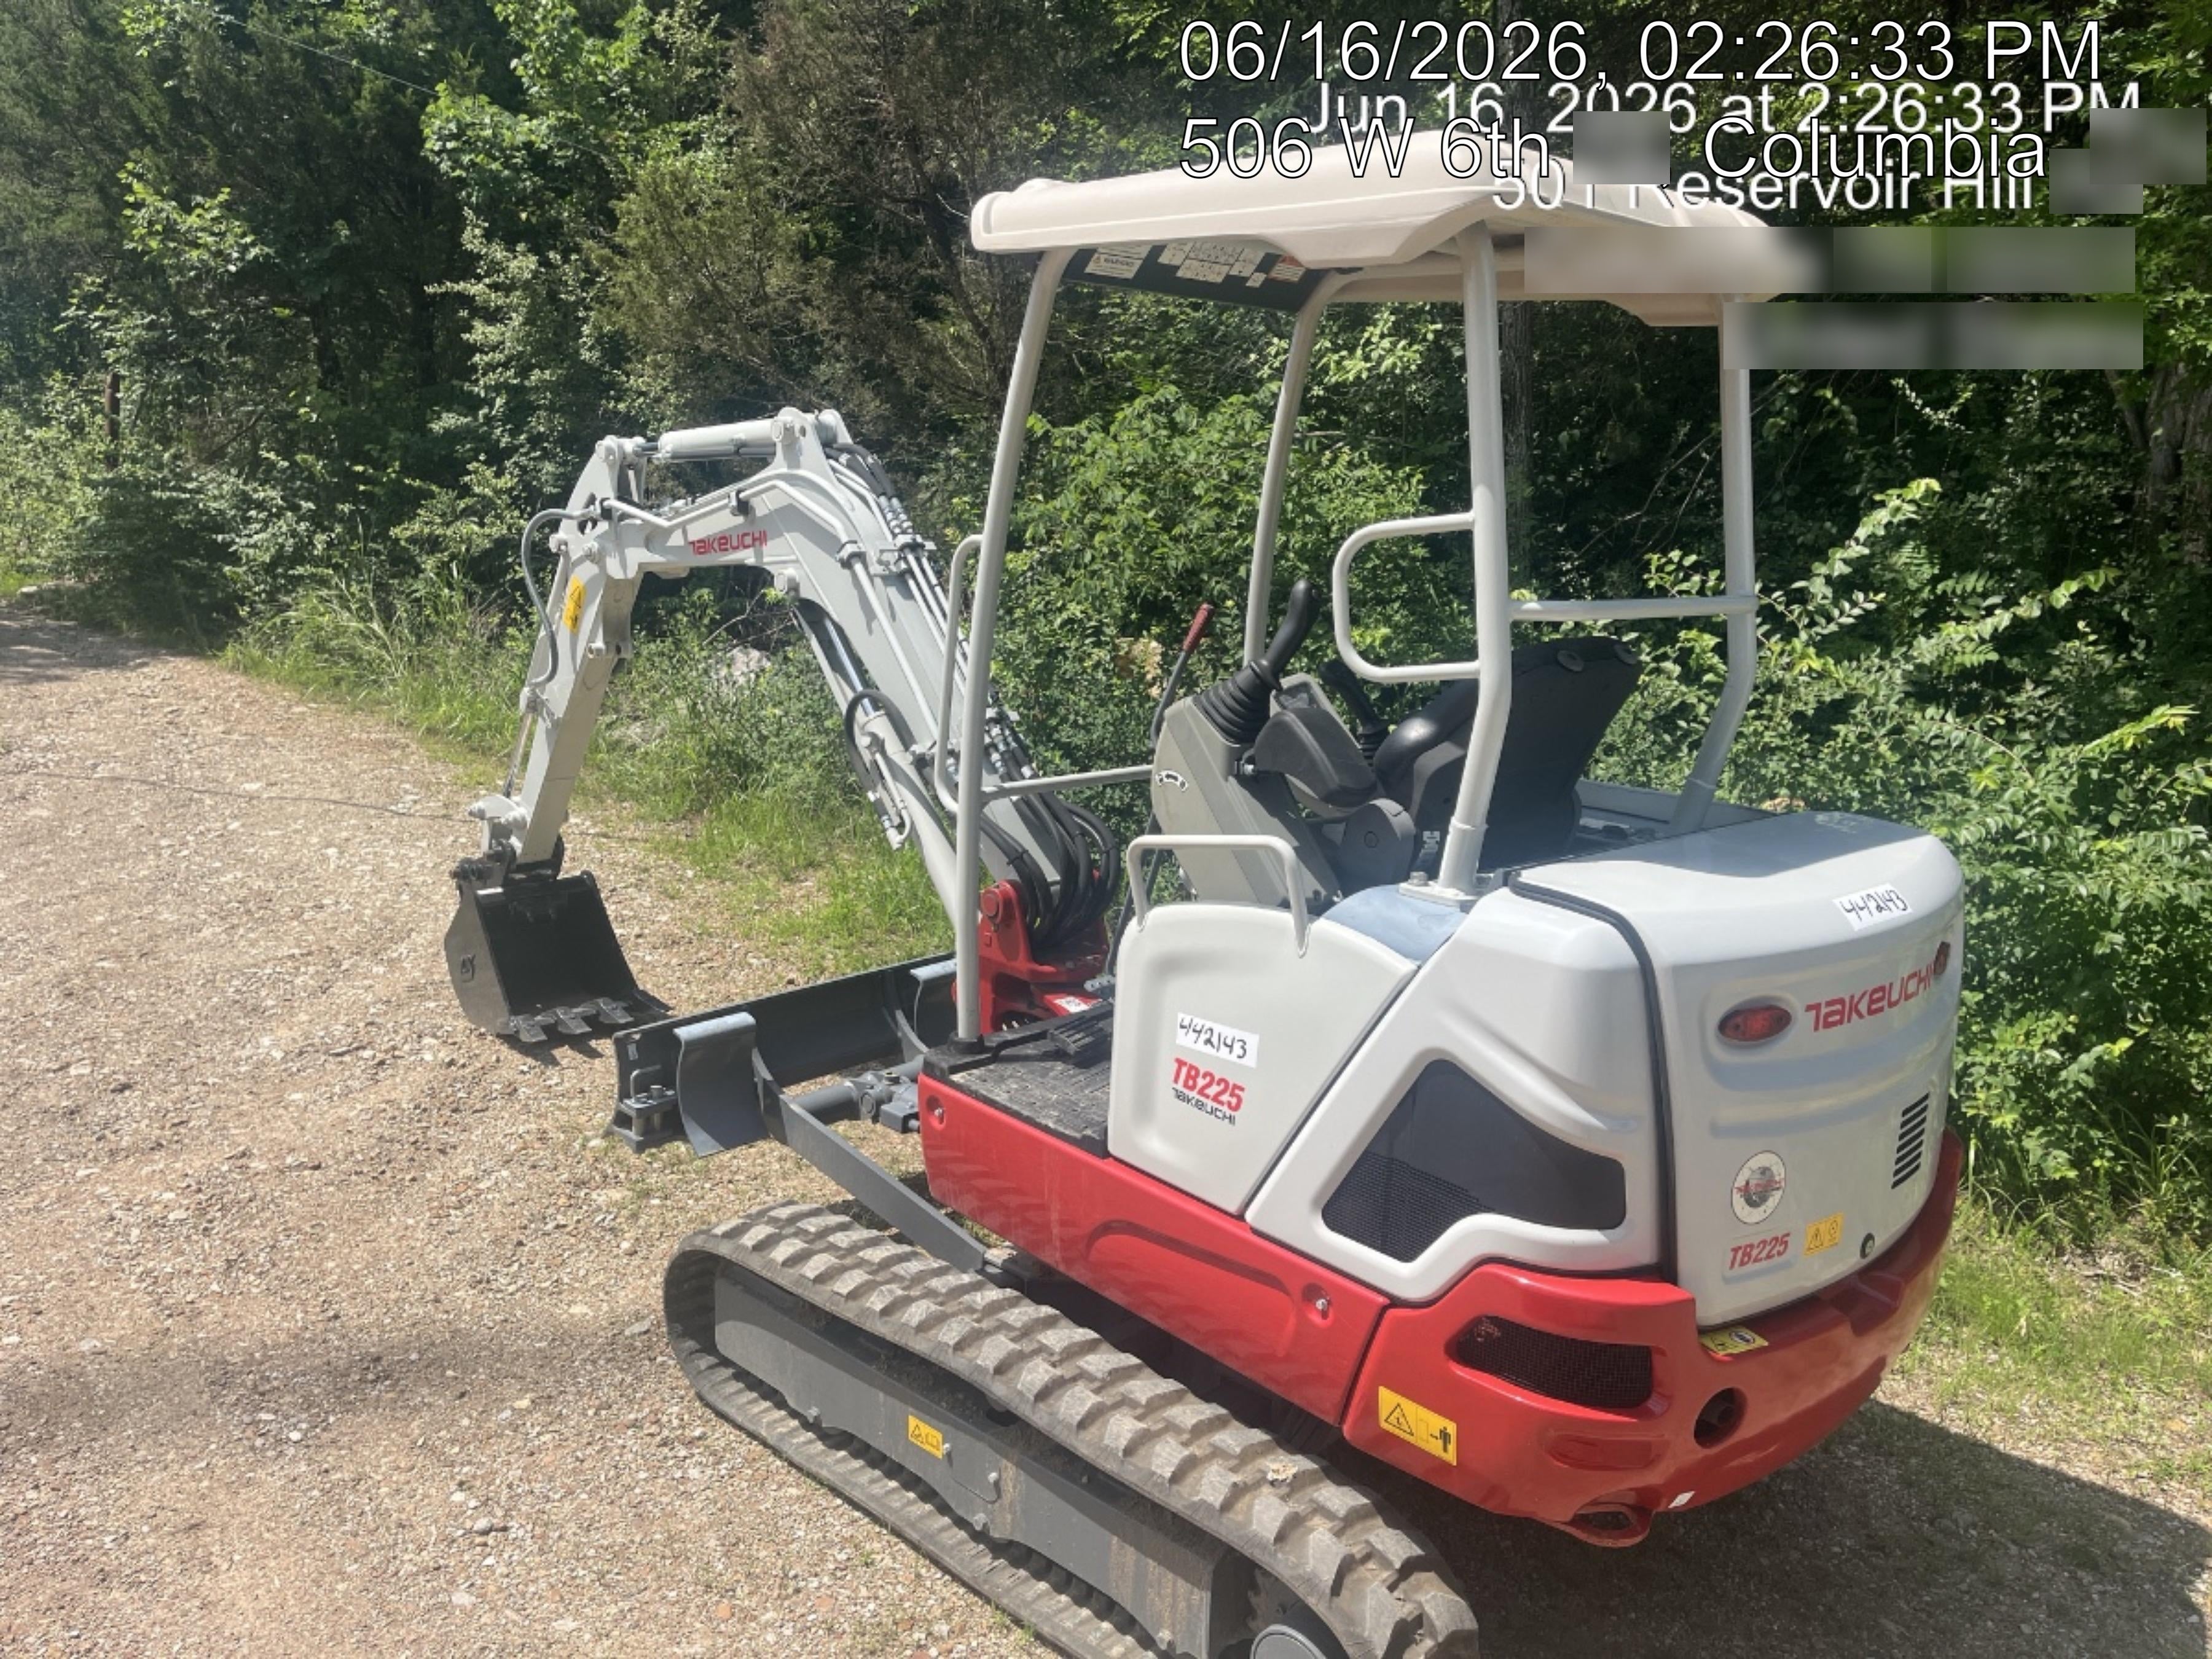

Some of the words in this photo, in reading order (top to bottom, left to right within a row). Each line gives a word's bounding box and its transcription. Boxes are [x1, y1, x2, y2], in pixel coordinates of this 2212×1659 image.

[1840, 890, 1908, 921] 442143
[1179, 1018, 1247, 1059] 442143
[1173, 1057, 1245, 1112] TB225
[1728, 1233, 1790, 1270] TB225
